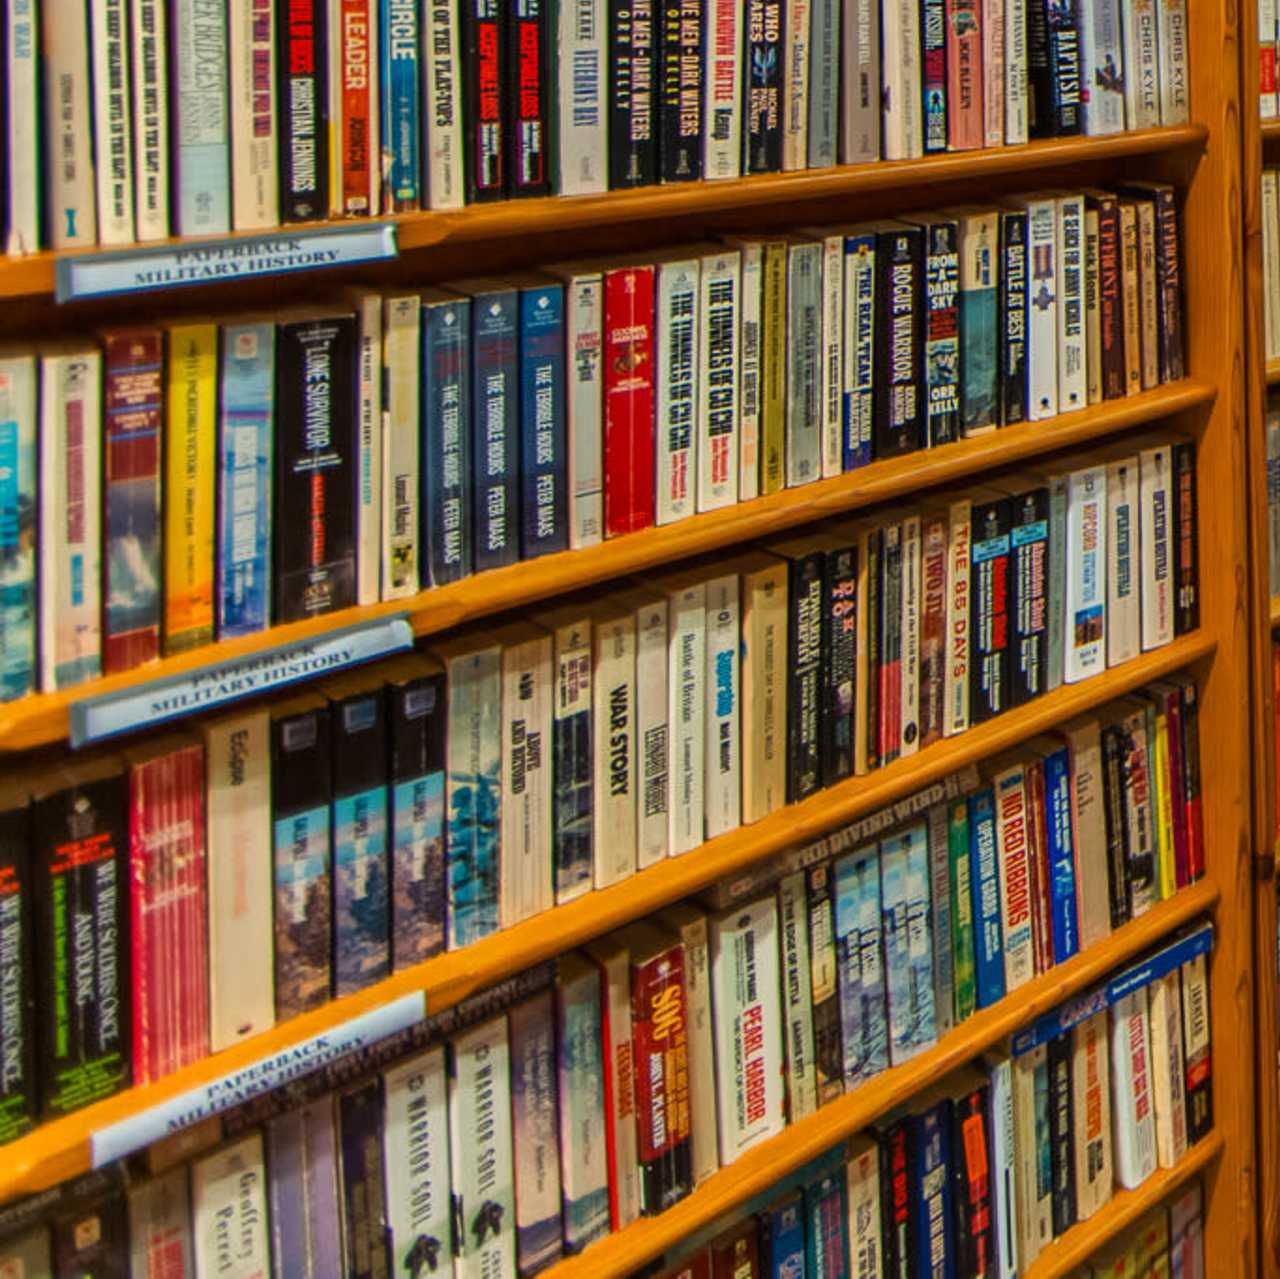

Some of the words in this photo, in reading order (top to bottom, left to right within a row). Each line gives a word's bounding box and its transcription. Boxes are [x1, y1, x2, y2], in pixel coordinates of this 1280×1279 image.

[433, 6, 449, 25] OF
[765, 0, 781, 42] WHO
[1142, 15, 1154, 60] CHRIS
[345, 12, 367, 90] LEADER
[433, 28, 450, 55] THE
[716, 59, 736, 101] BATTLE
[1057, 31, 1080, 106] BAPTISM
[1142, 65, 1155, 111] KYLE
[290, 78, 313, 135] CHRISTIAN
[435, 60, 453, 126] FLAT-TOPS
[711, 108, 734, 141] Kemp
[292, 138, 316, 192] JENNINGS
[134, 262, 240, 286] MILITARY
[247, 249, 340, 272] HISTORY
[174, 238, 301, 267] PAPERBACK
[708, 281, 733, 305] THE
[858, 268, 871, 300] THE
[892, 265, 911, 313] ROGUE
[708, 308, 733, 368] TUNNELS
[858, 303, 871, 339] REAL
[305, 347, 331, 382] LONE
[858, 340, 871, 387] TEAM
[893, 316, 912, 382] WARRIOR
[536, 365, 552, 385] THE
[709, 371, 733, 391] OF
[305, 384, 331, 449] SURVIVOR
[536, 386, 553, 430] TERRIBLE
[709, 392, 734, 412] CU
[709, 414, 734, 436] CHI
[848, 392, 861, 449] MARCINKO
[859, 392, 872, 442] RICHARD
[535, 431, 553, 464] HOURS
[537, 475, 553, 504] PETER
[537, 505, 554, 537] MAAS
[954, 527, 969, 573] THE
[954, 582, 968, 610] 85
[954, 620, 967, 678] DAYS
[151, 675, 258, 714] MILITARY
[263, 649, 356, 683] HISTORY
[610, 685, 628, 734] WAR
[229, 731, 250, 786] Eclipse
[611, 738, 629, 797] STORY
[1003, 794, 1022, 819] NO
[1004, 820, 1023, 853] RED
[97, 861, 116, 885] WE
[1005, 856, 1028, 927] RIBBONS
[97, 886, 116, 925] WERE
[75, 913, 92, 949] AND
[76, 949, 94, 1005] YOUNG
[98, 927, 117, 996] SOLDIERS
[651, 988, 683, 1041] SOG
[743, 1005, 764, 1058] PEARL
[473, 1068, 494, 1141] WARRIOR
[745, 1060, 766, 1124] HARBOR
[476, 1148, 496, 1194] SOUL
[236, 1172, 259, 1260] Geoffrey
[214, 1206, 233, 1273] Perret
